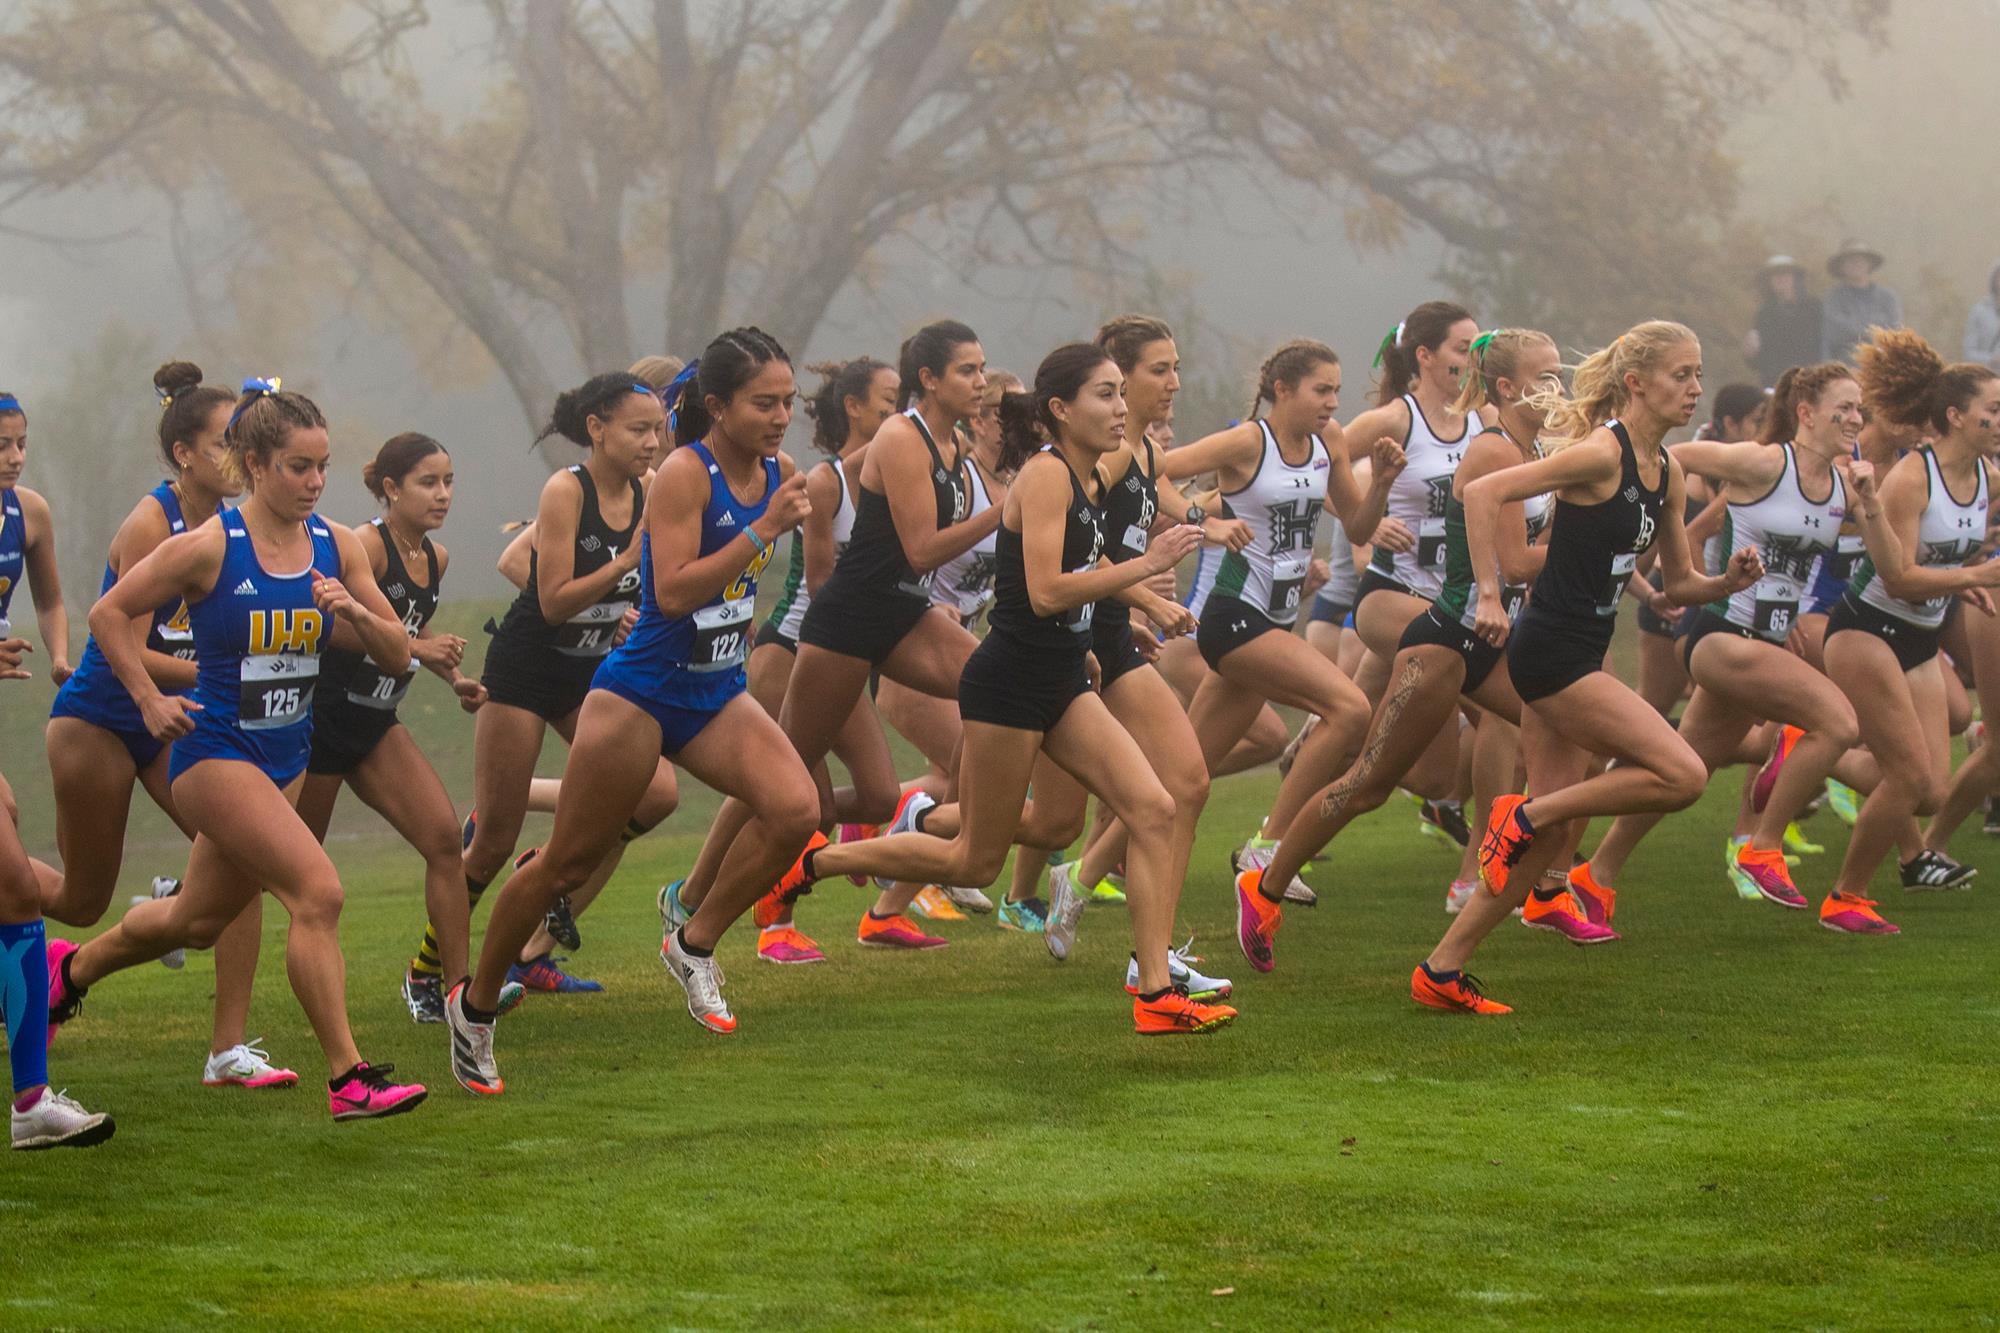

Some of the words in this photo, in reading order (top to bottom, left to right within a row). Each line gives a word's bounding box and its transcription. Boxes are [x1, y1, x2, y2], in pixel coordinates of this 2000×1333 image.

[1769, 609, 1789, 631] 65
[577, 629, 603, 648] 74
[711, 631, 739, 662] 122
[371, 675, 396, 700] 70
[261, 687, 300, 718] 125
